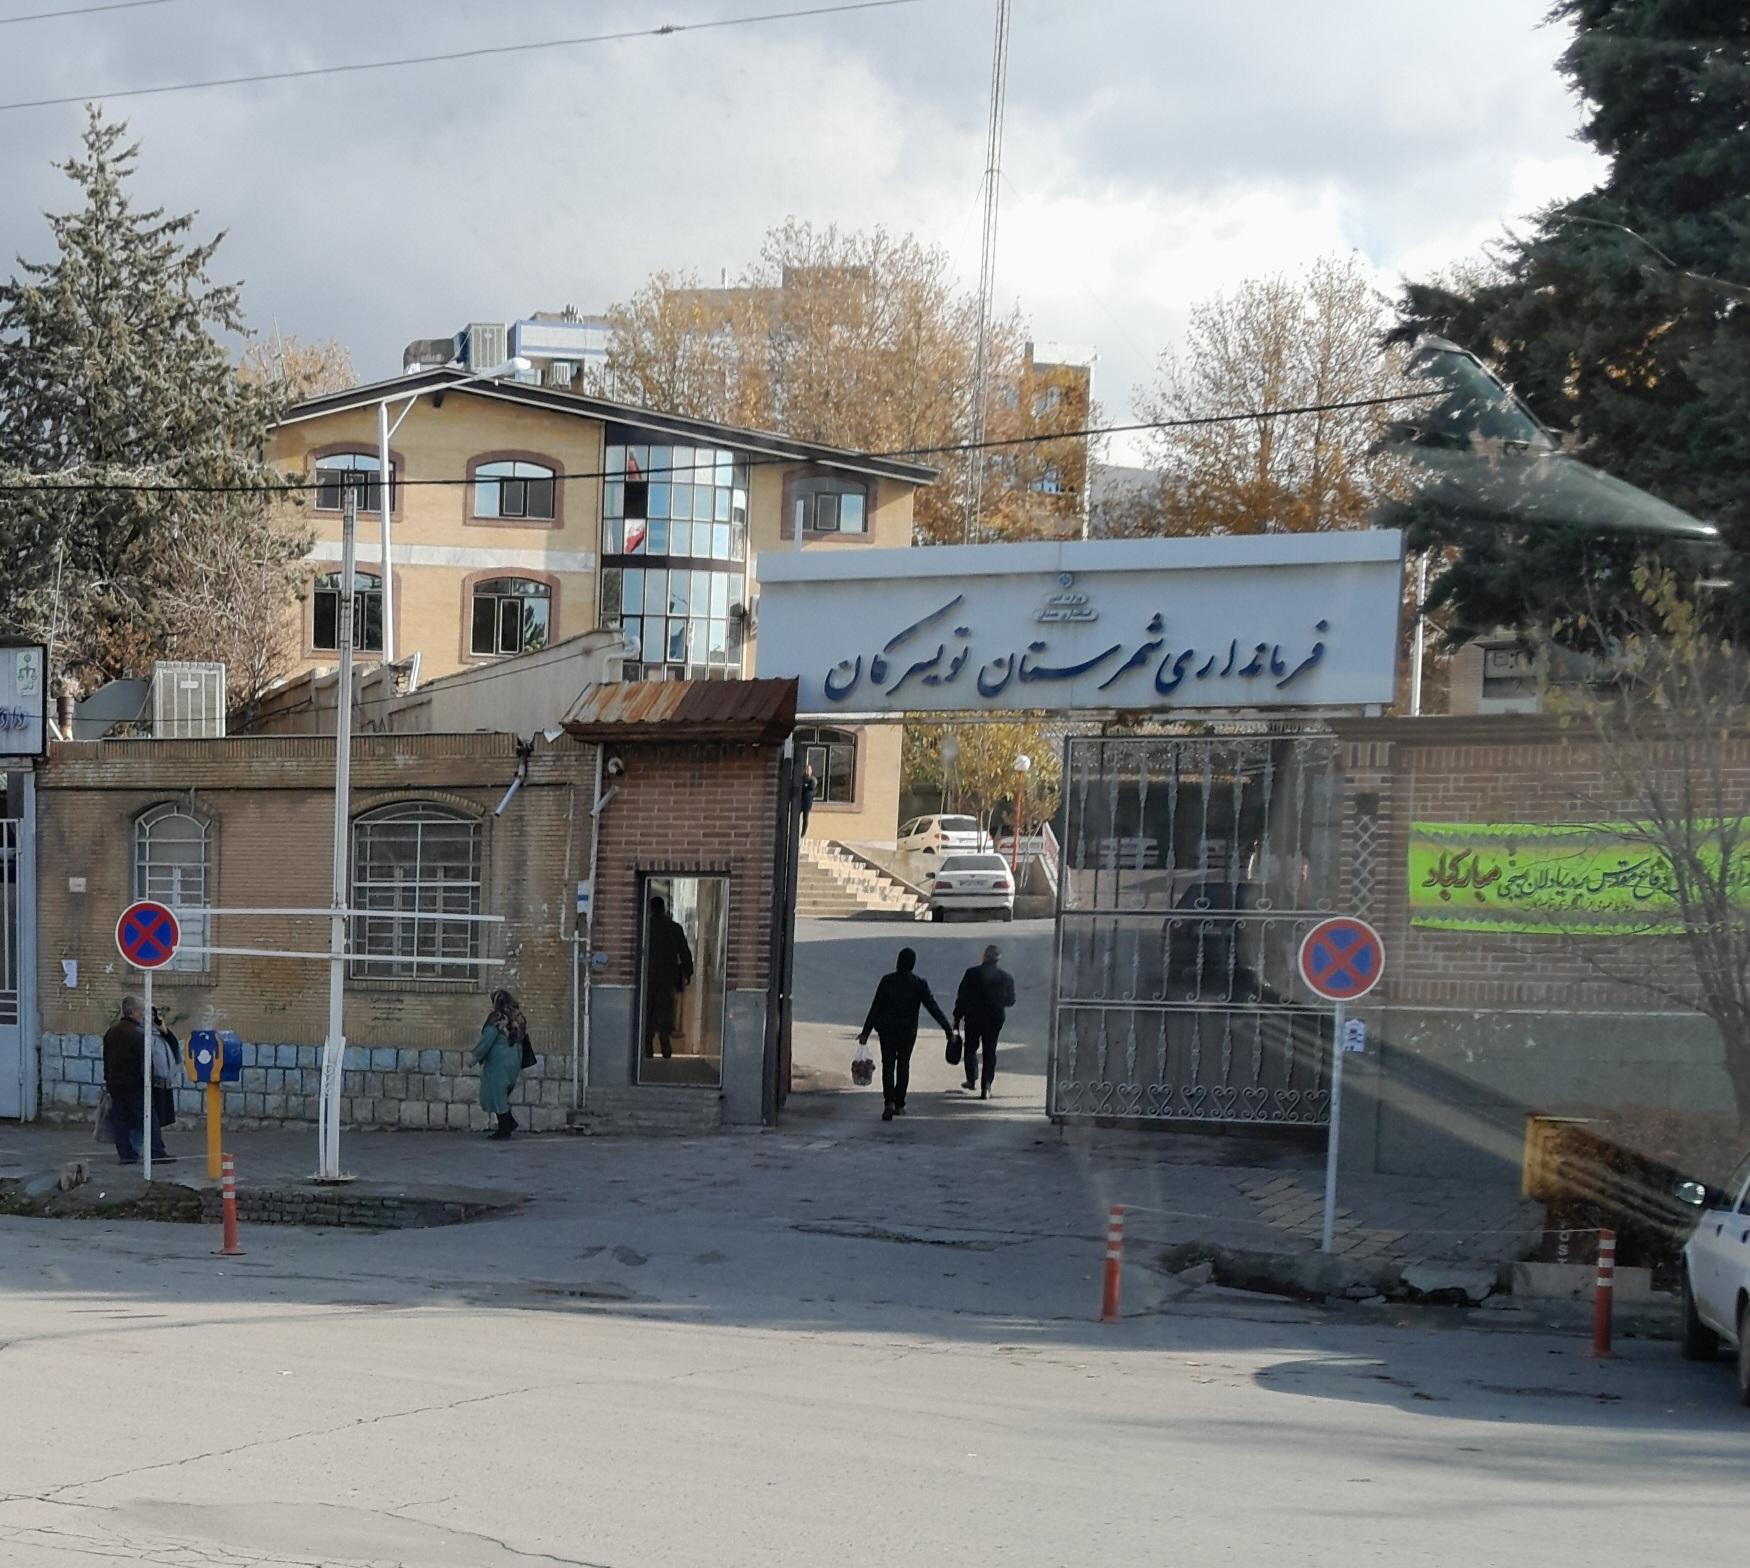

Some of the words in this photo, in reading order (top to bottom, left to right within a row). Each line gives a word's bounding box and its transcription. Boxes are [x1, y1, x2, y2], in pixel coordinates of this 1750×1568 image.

[823, 593, 970, 701] تویسرکان
[976, 611, 1165, 699] شهرستان
[1154, 618, 1329, 697] فرمانداری
[1421, 847, 1502, 902] مبارکباد
